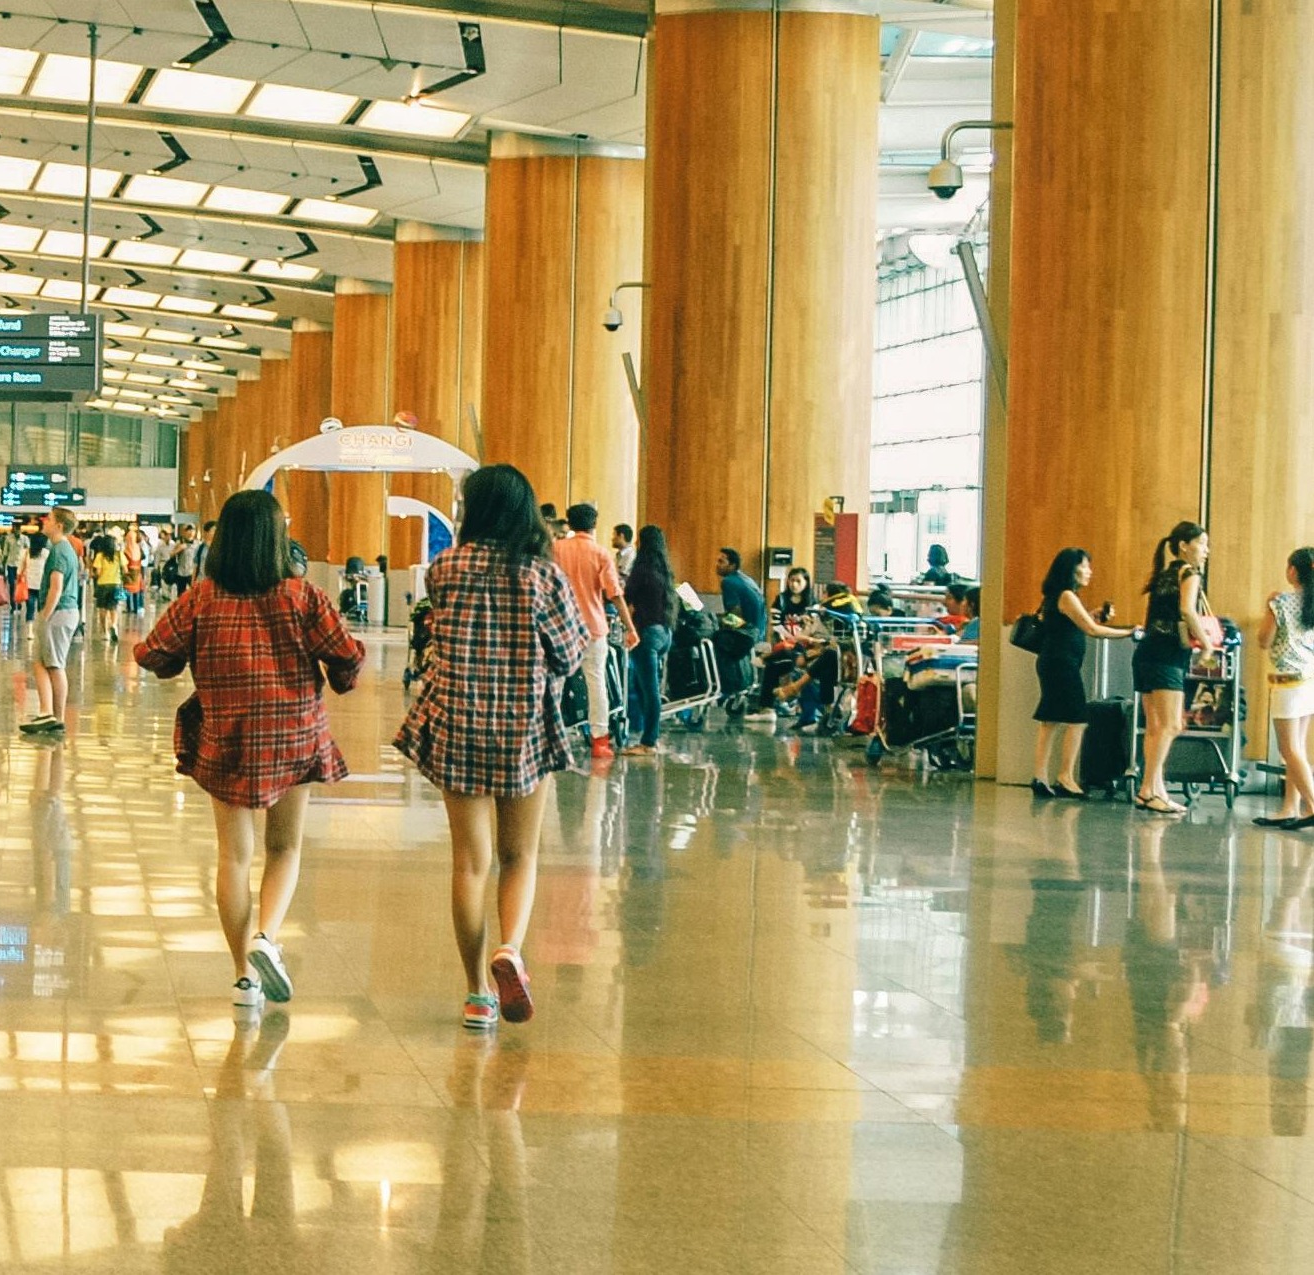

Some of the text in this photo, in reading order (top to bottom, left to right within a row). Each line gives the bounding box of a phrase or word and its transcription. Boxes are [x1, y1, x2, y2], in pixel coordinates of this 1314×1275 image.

[0, 346, 41, 359] Changer
[13, 372, 41, 382] Room
[339, 434, 412, 447] CHANGI
